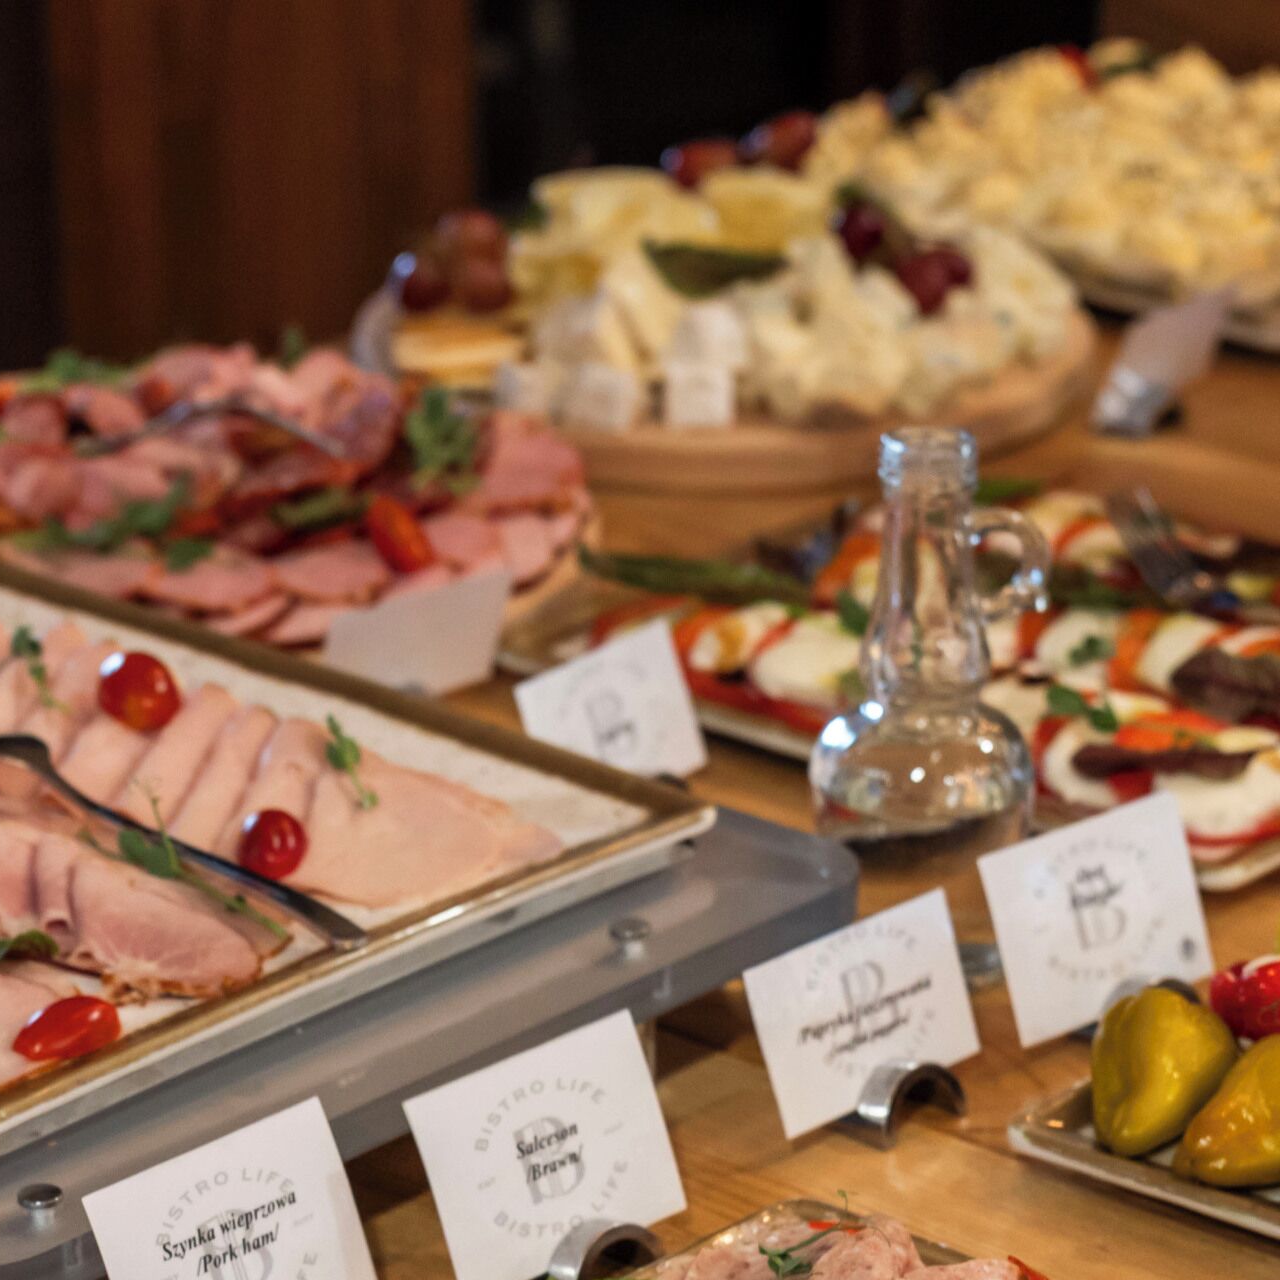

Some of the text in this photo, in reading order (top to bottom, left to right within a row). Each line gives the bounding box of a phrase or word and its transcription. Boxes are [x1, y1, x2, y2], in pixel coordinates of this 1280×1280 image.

[474, 1077, 606, 1152] BISTRO LIFE
[516, 1123, 579, 1160] Salceson
[156, 1167, 296, 1246] BISTRO LIFE
[161, 1192, 297, 1262] Szynka wieprzowa
[196, 1223, 280, 1277] /Pork ham/
